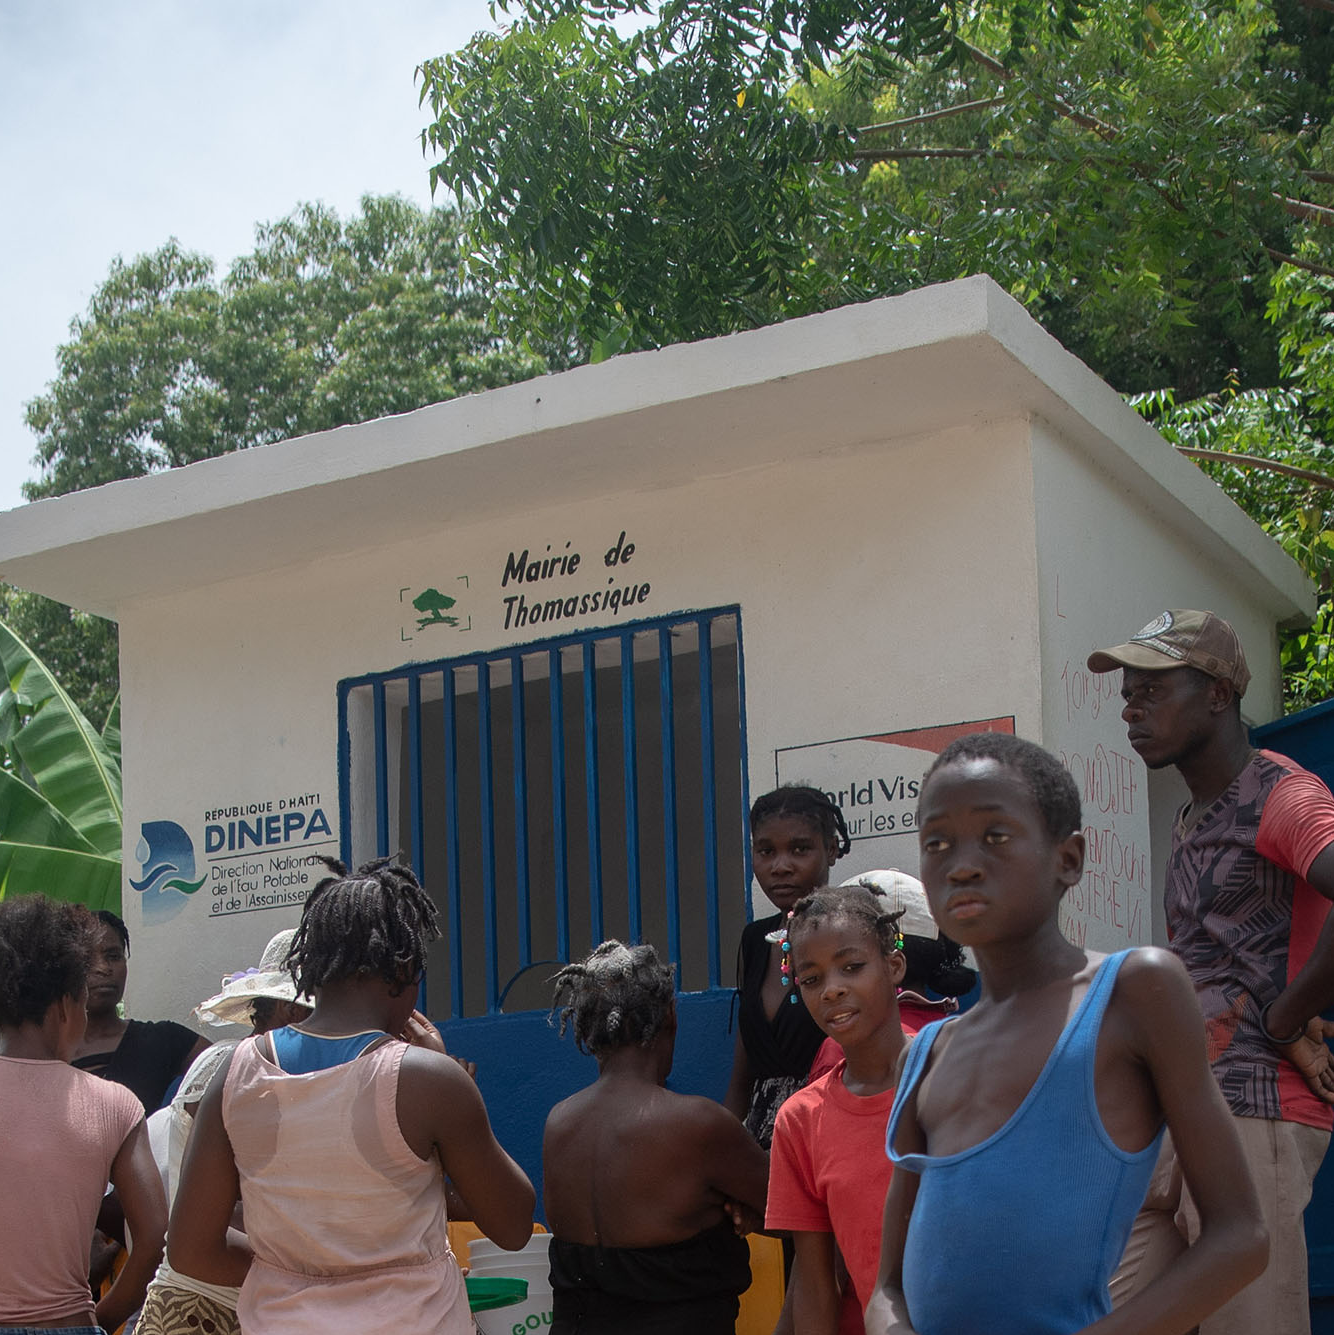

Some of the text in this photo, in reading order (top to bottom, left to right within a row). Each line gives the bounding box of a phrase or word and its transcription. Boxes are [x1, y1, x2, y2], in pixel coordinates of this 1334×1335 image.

[501, 530, 635, 588] Mairie de
[503, 577, 651, 630] Thomassique
[819, 775, 920, 808] orld Vis
[205, 808, 332, 853] DINEPA
[870, 810, 895, 832] les
[211, 862, 264, 881] Direction
[211, 871, 308, 896] de l'Eau Potable
[211, 889, 312, 913] et de l'Assainisse
